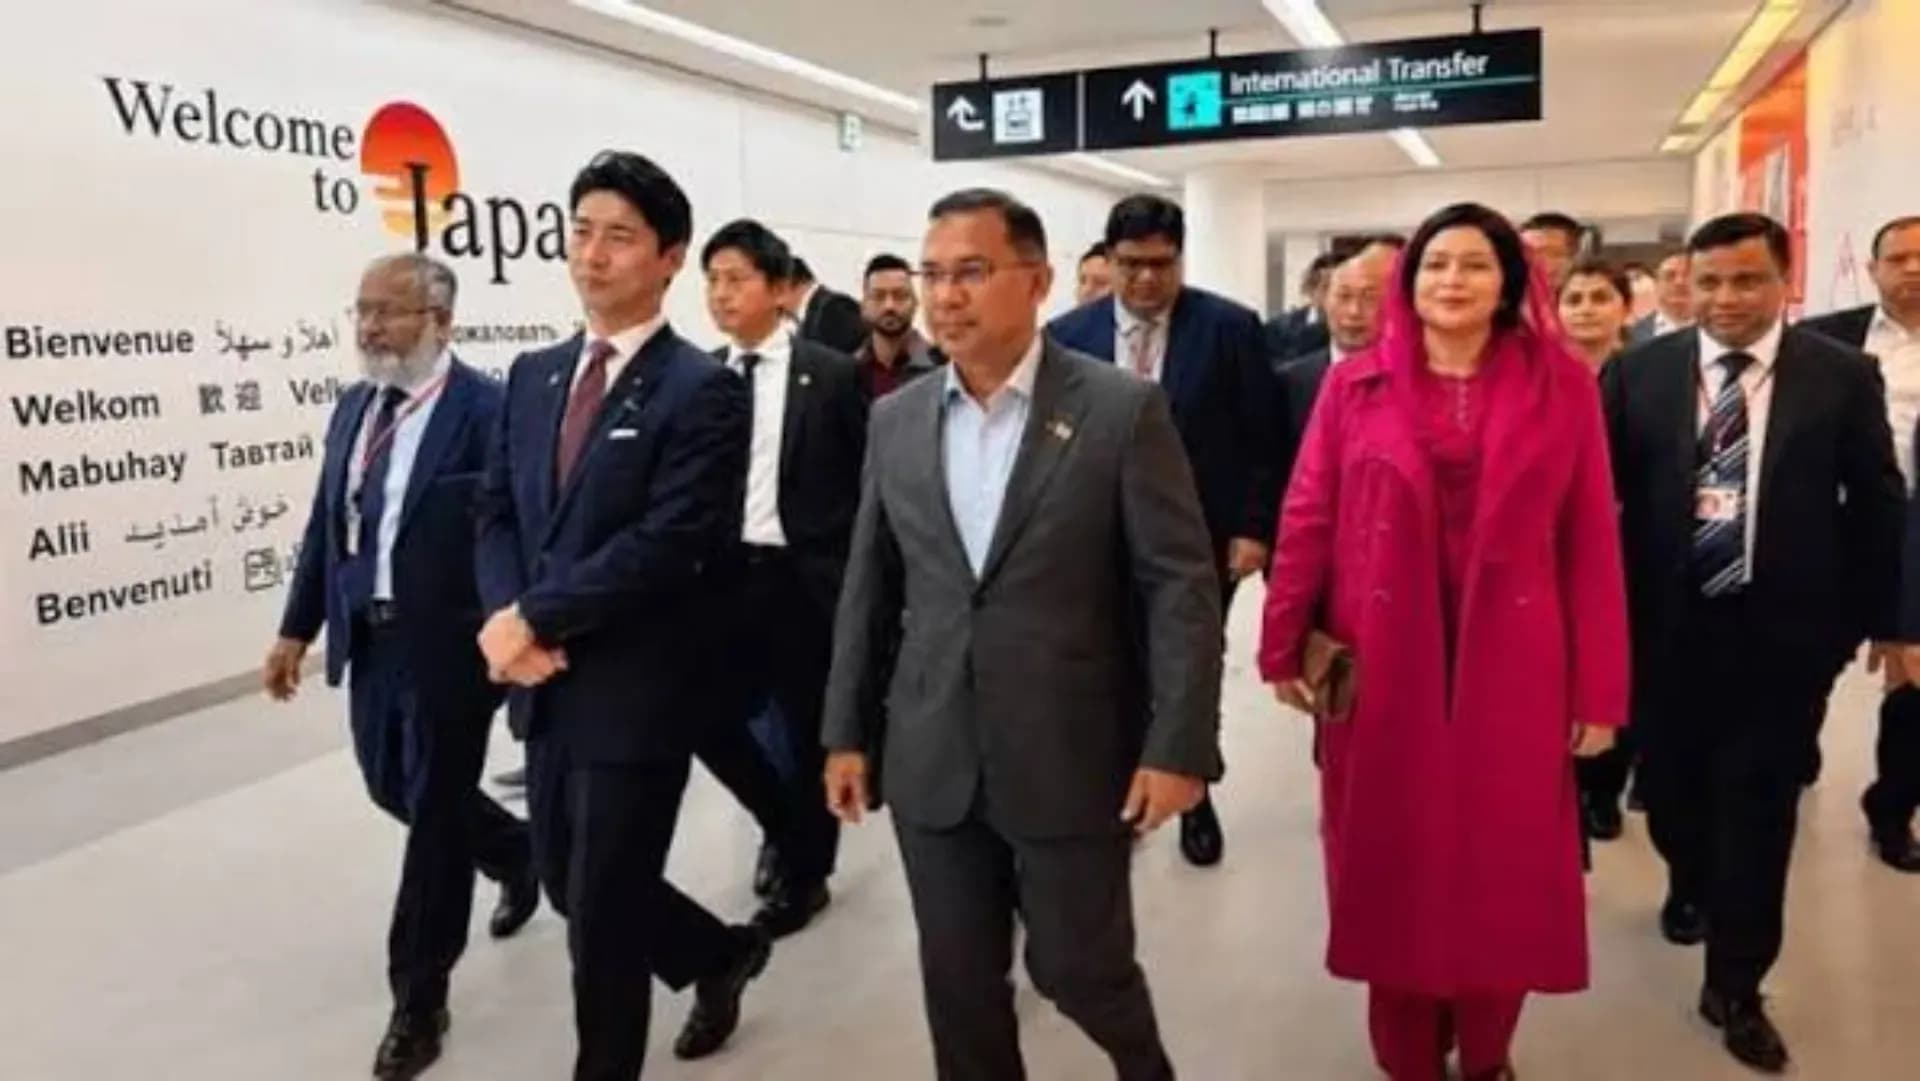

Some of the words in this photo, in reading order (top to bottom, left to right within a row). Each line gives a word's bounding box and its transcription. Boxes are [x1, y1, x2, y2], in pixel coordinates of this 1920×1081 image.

[1231, 59, 1380, 93] International
[1389, 51, 1488, 81] Transfer
[102, 76, 355, 161] Welcome
[312, 165, 359, 215] to
[405, 161, 567, 284] Japa
[5, 326, 195, 360] Bienvenue
[9, 387, 161, 428] Welkom
[18, 450, 188, 496] Mabuhay
[209, 435, 315, 471] Тавтай
[28, 520, 91, 562] Alii
[36, 558, 213, 626] Benvenuti
